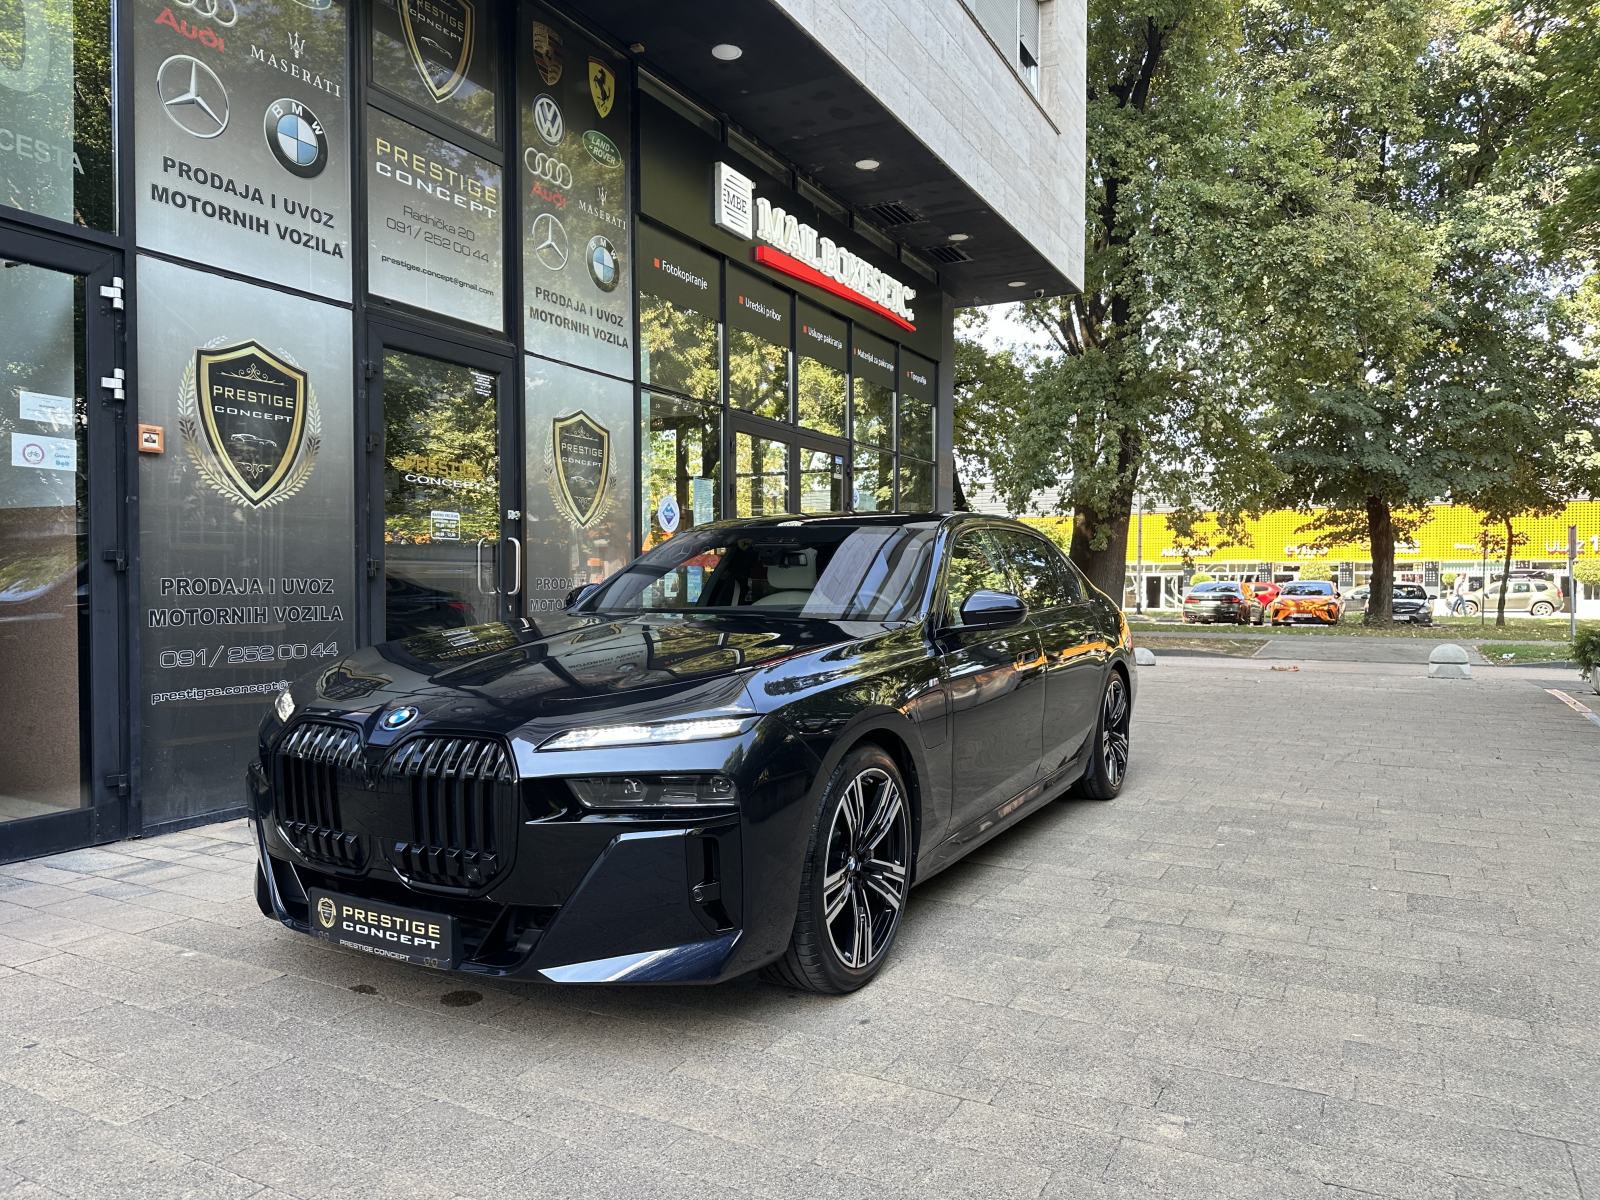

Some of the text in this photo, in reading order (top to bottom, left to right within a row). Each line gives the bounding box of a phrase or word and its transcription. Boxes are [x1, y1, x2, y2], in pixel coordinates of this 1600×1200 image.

[154, 7, 225, 54] Audi
[404, 8, 462, 42] CONCEPT
[415, 0, 464, 32] RESTIGE
[250, 44, 341, 98] MASERATI
[271, 102, 324, 136] BMW
[592, 136, 610, 152] LAND
[592, 146, 616, 164] ROVER
[376, 138, 497, 204] PRESTIGE
[163, 156, 335, 229] PRODAJA I UVOZ
[376, 162, 497, 218] CONCEPT
[727, 190, 747, 214] MBE
[151, 184, 344, 260] MOTORNIH VOZILA
[404, 205, 475, 242] Radnička 20
[578, 200, 626, 230] MASERATI
[424, 232, 450, 250] 252
[454, 242, 470, 257] 00
[473, 249, 489, 263] 44
[590, 239, 617, 260] BMW
[756, 197, 822, 271] MAIL
[820, 236, 881, 303] BOXES
[381, 254, 494, 296] prestigee.concept@gmail.com
[662, 260, 708, 290] Fotokopiranje
[536, 286, 624, 328] PRODAJA I UVOZ
[746, 297, 782, 322] Uredski pribor
[530, 306, 628, 348] MOTORNIH VOZILA
[213, 385, 295, 410] PRESTIGE
[214, 405, 294, 424] CONCEPT
[561, 442, 603, 458] PRESTIGE
[562, 456, 602, 468] CONCEPT
[404, 474, 480, 490] CONCEPT
[160, 578, 334, 596] PRODAJA I UVOZ
[148, 606, 344, 628] MOTORNIH VOZILA
[228, 646, 274, 664] 252
[278, 644, 308, 660] 00
[310, 642, 338, 658] 44
[151, 680, 293, 705] prestigee.concept@
[342, 905, 441, 938] PRESTIGE
[342, 921, 440, 950] CONCEPT
[340, 938, 411, 962] PRESTIGE CONCEPT
